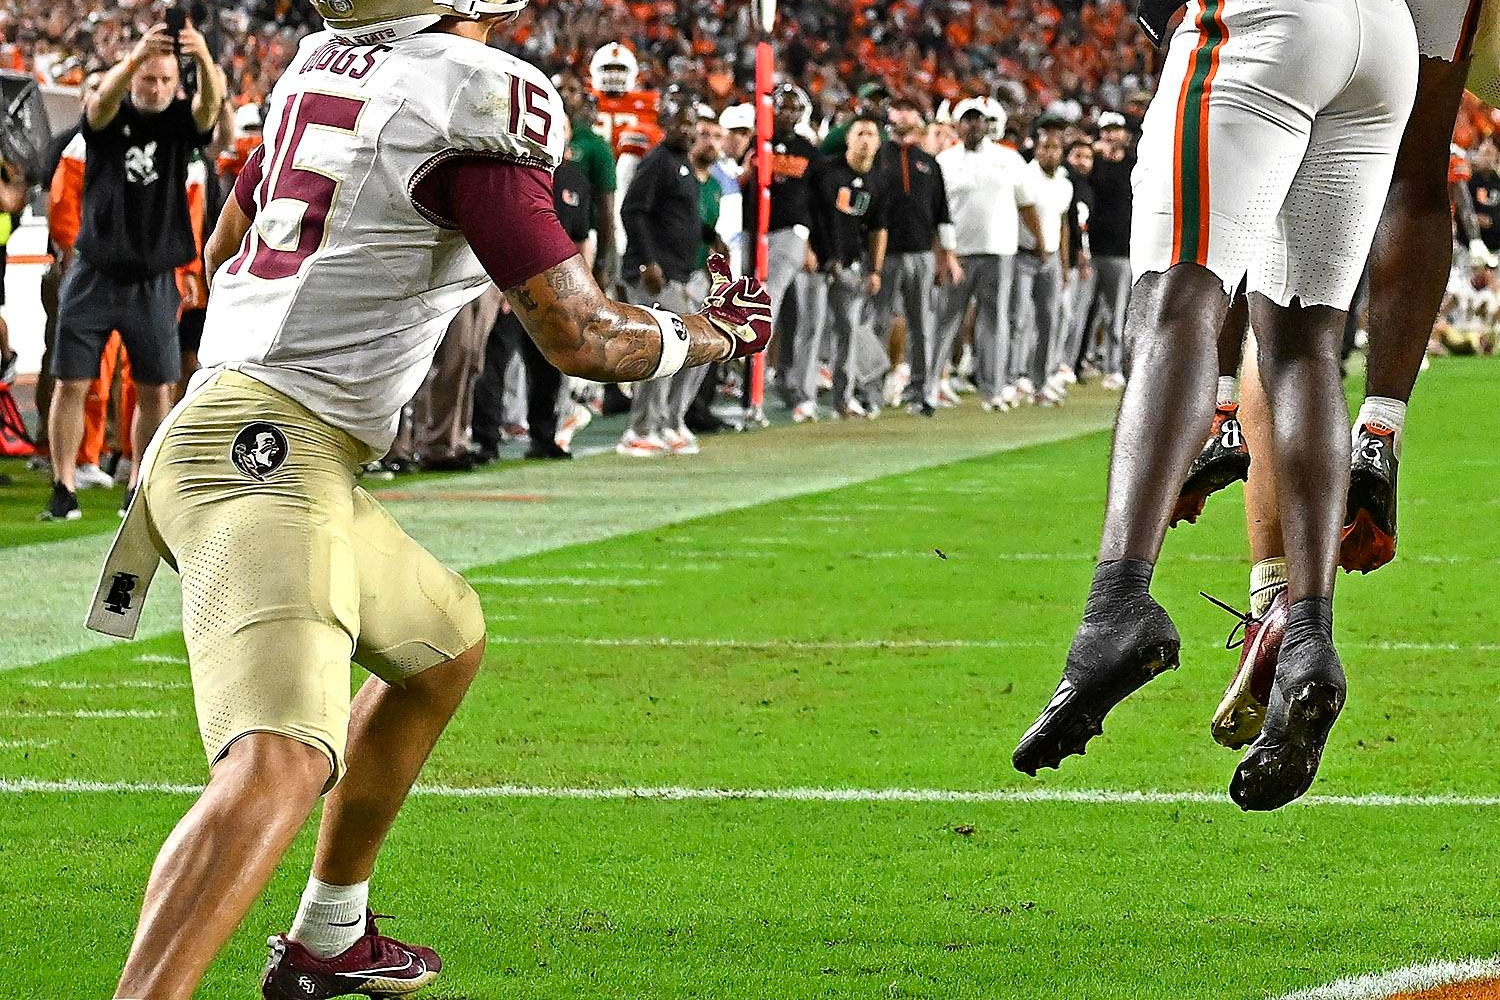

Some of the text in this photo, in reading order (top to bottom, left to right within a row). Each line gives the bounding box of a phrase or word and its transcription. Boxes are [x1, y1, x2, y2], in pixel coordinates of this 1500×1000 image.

[353, 27, 397, 46] STATE
[507, 72, 553, 148] 15
[226, 88, 372, 281] 15
[298, 975, 316, 995] FSU
